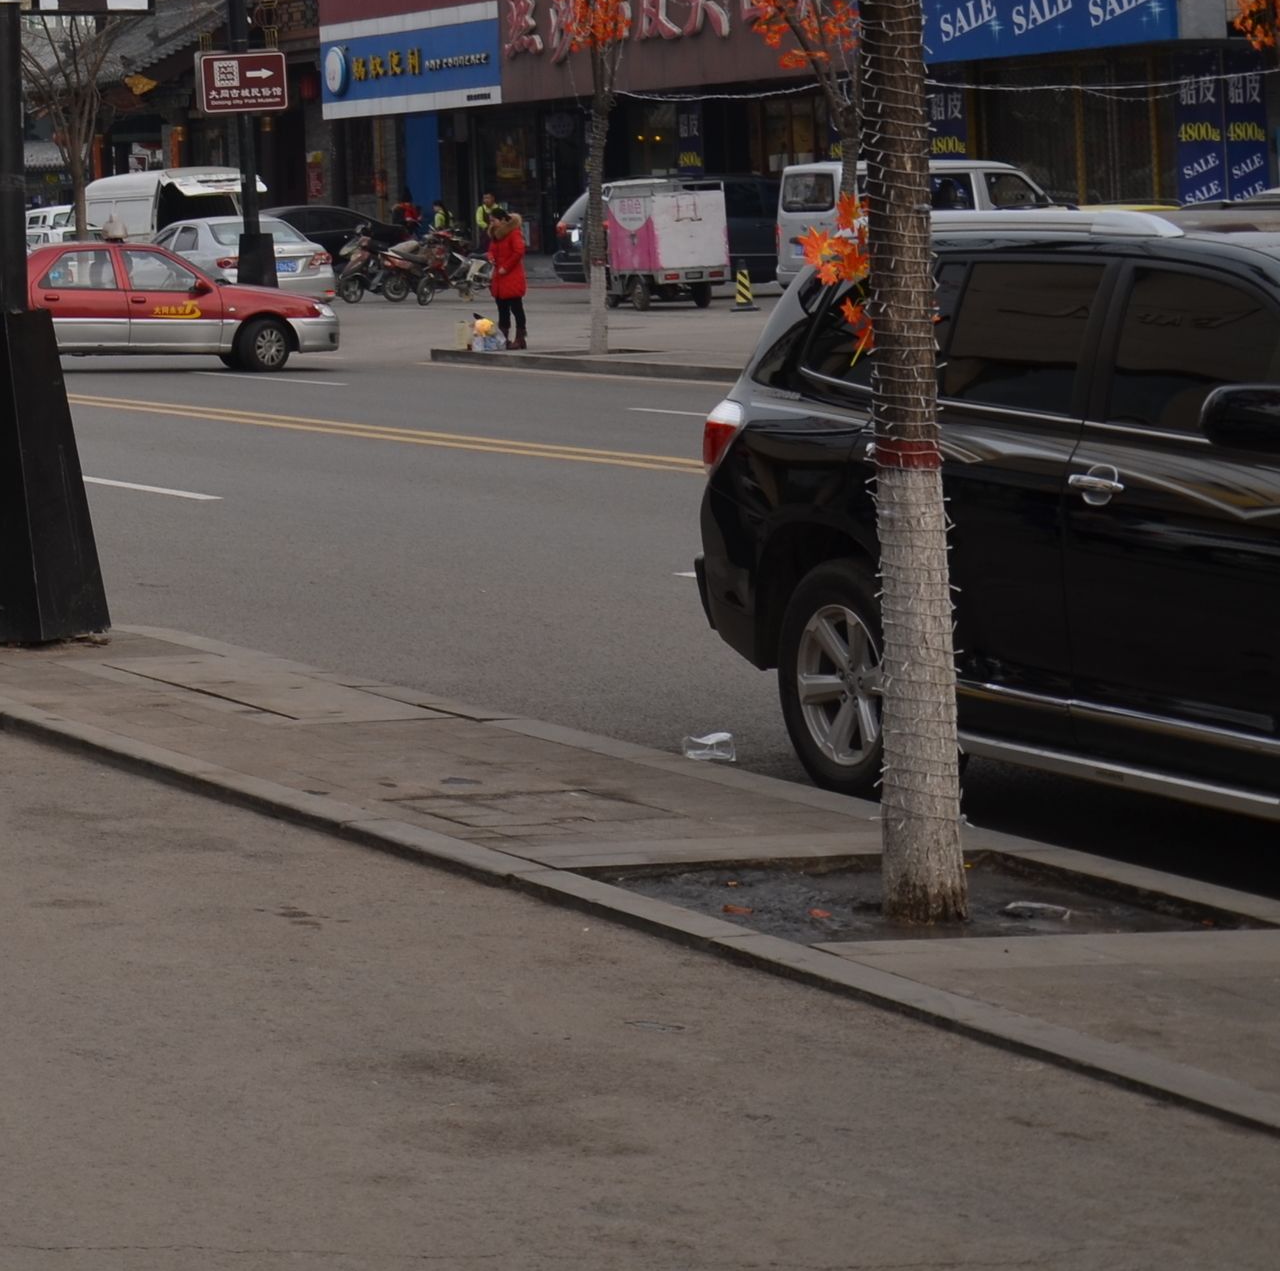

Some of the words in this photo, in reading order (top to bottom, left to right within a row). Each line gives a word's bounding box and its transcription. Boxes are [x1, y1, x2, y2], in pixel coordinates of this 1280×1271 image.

[208, 87, 282, 99] 大同古城民俗馆
[1183, 152, 1220, 179] SALE
[1231, 152, 1265, 179] SALE
[1184, 180, 1222, 205] SALE
[1233, 180, 1266, 202] SALE
